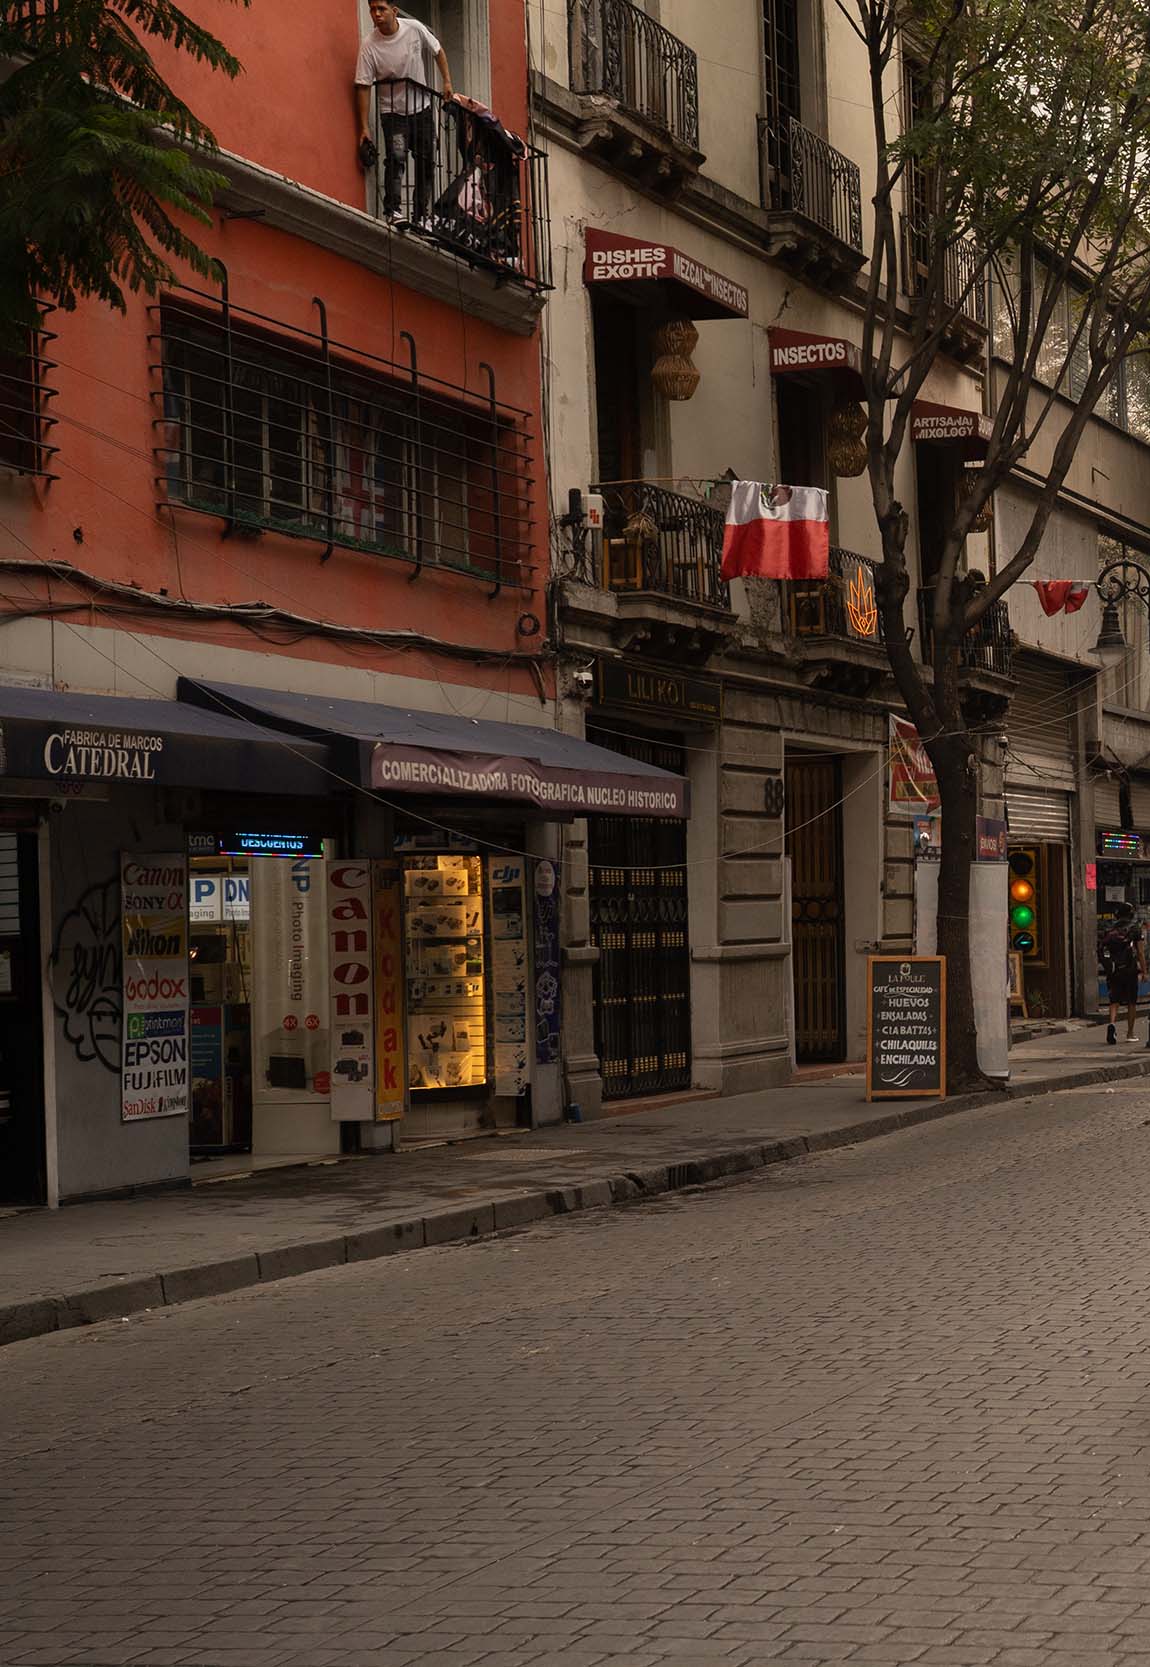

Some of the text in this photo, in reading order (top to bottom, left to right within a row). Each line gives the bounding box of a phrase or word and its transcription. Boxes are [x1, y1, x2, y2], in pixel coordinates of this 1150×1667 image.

[592, 247, 666, 264] DISHES
[673, 253, 748, 312] MEZCAL INSECTOS
[773, 343, 846, 366] INSECTOS
[63, 730, 163, 752] FABRICA DE MARCOS
[44, 733, 156, 780] CATEDRAL
[381, 760, 677, 810] COMERCIALIZADORA FOTOGRAFICA NUCLEO HISTORICO
[123, 862, 185, 887] Canon
[125, 895, 166, 910] SONY
[127, 928, 181, 956] Nikon
[290, 902, 304, 1001] Photo Imaging
[329, 866, 370, 1016] Canon
[888, 998, 930, 1008] HUEVOS
[881, 1011, 928, 1022] ENSALADAS
[124, 1039, 186, 1067] EPSON
[880, 1040, 938, 1052] CHILAQUILES
[880, 1055, 936, 1066] ENCHILADAS
[123, 1067, 186, 1091] FUJIFILM
[123, 1098, 156, 1118] SanDisk
